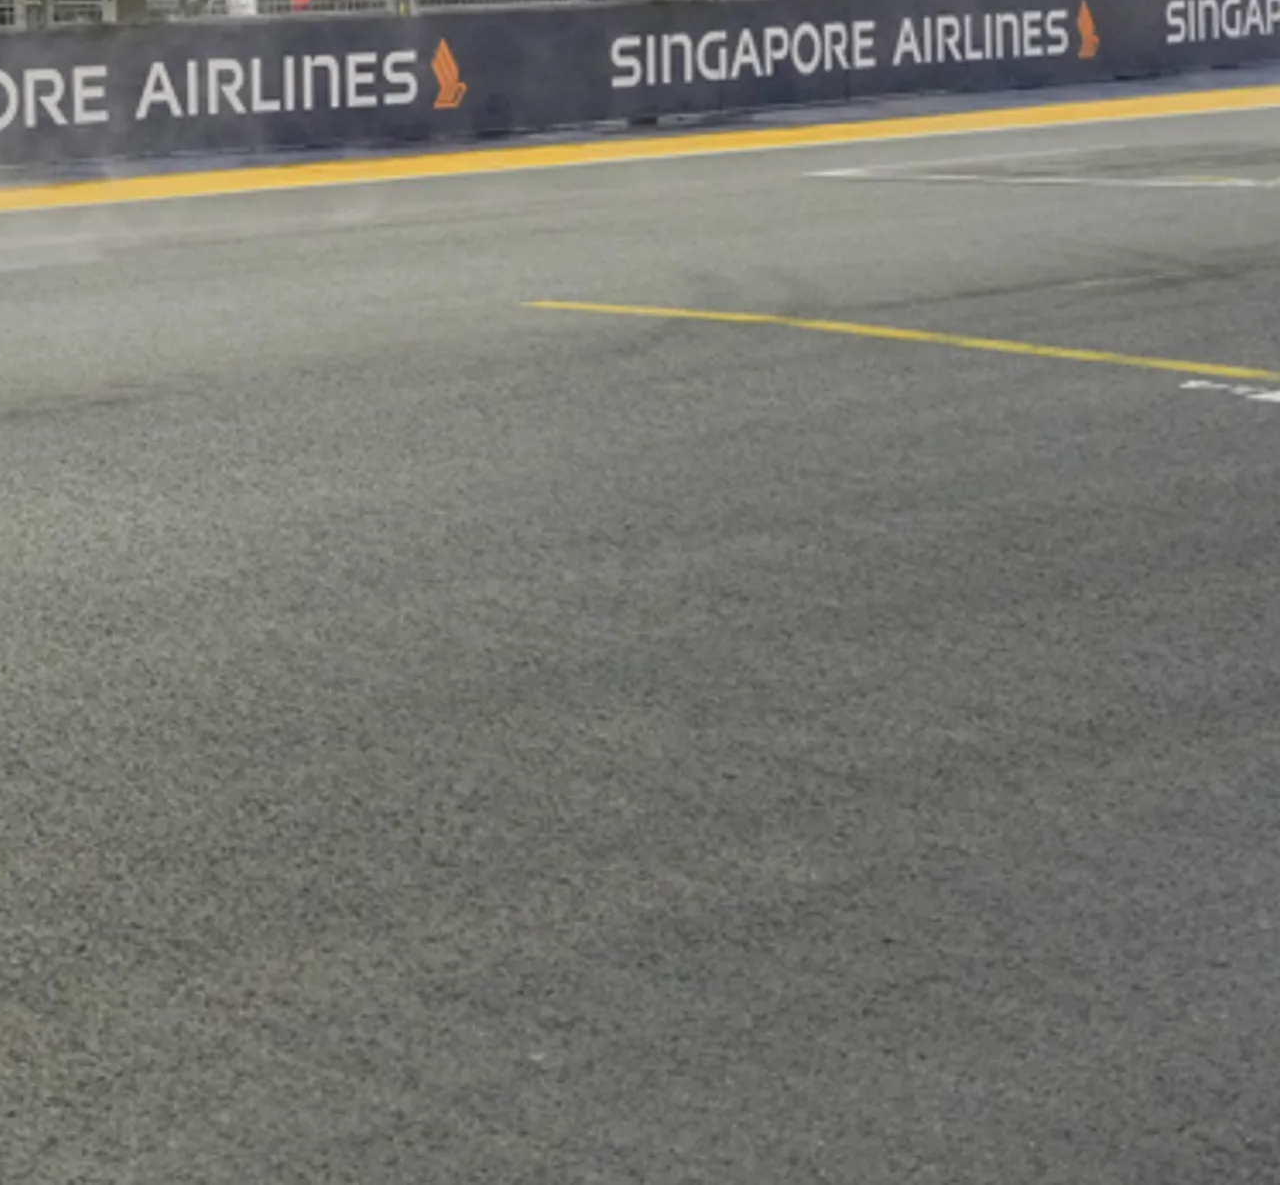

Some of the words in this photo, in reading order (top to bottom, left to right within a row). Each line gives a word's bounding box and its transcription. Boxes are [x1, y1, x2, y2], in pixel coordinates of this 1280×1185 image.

[135, 49, 419, 120] AIRLINES
[610, 20, 877, 88] SINGAPORE
[892, 9, 1070, 66] AIRLINES
